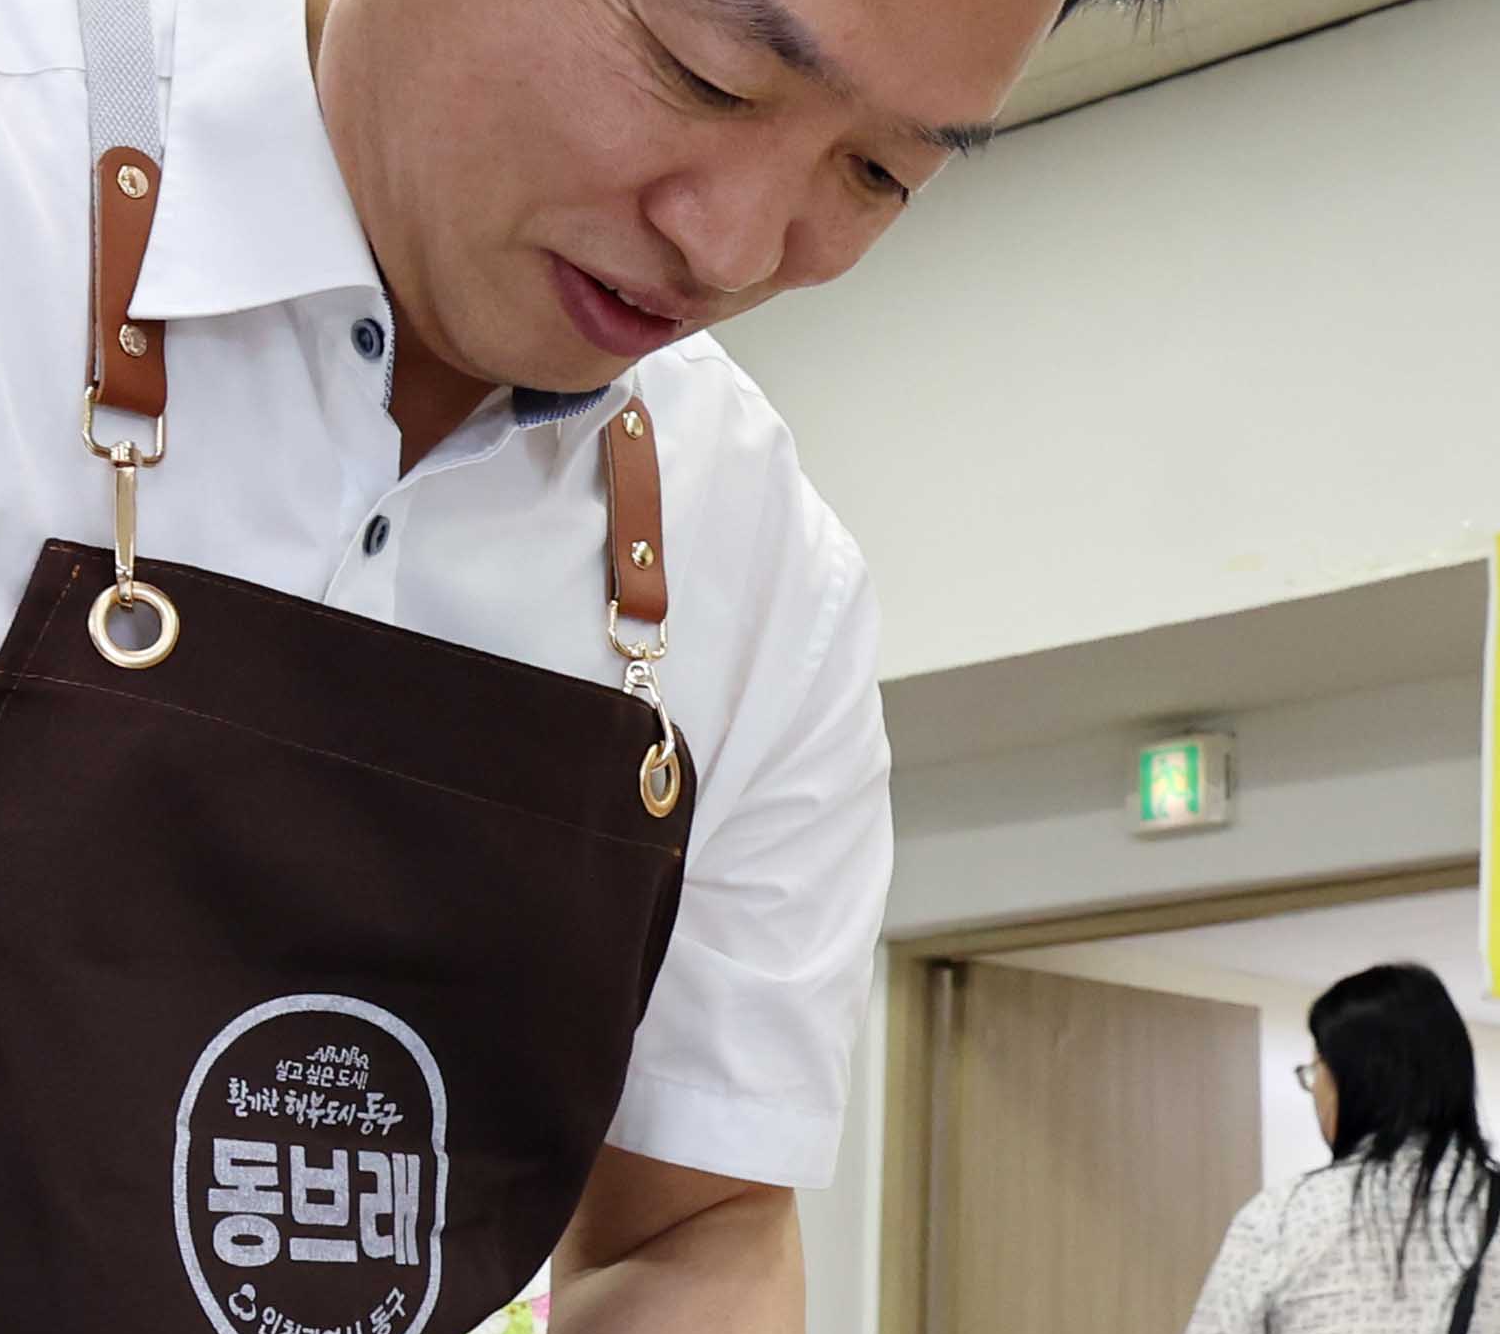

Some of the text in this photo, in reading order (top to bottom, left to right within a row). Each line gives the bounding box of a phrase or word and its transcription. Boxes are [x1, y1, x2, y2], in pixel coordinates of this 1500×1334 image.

[275, 1059, 369, 1090] 살고 싶은 도시!
[227, 1077, 404, 1136] 활기찬 행복도시 동구
[207, 1137, 421, 1267] 동브래
